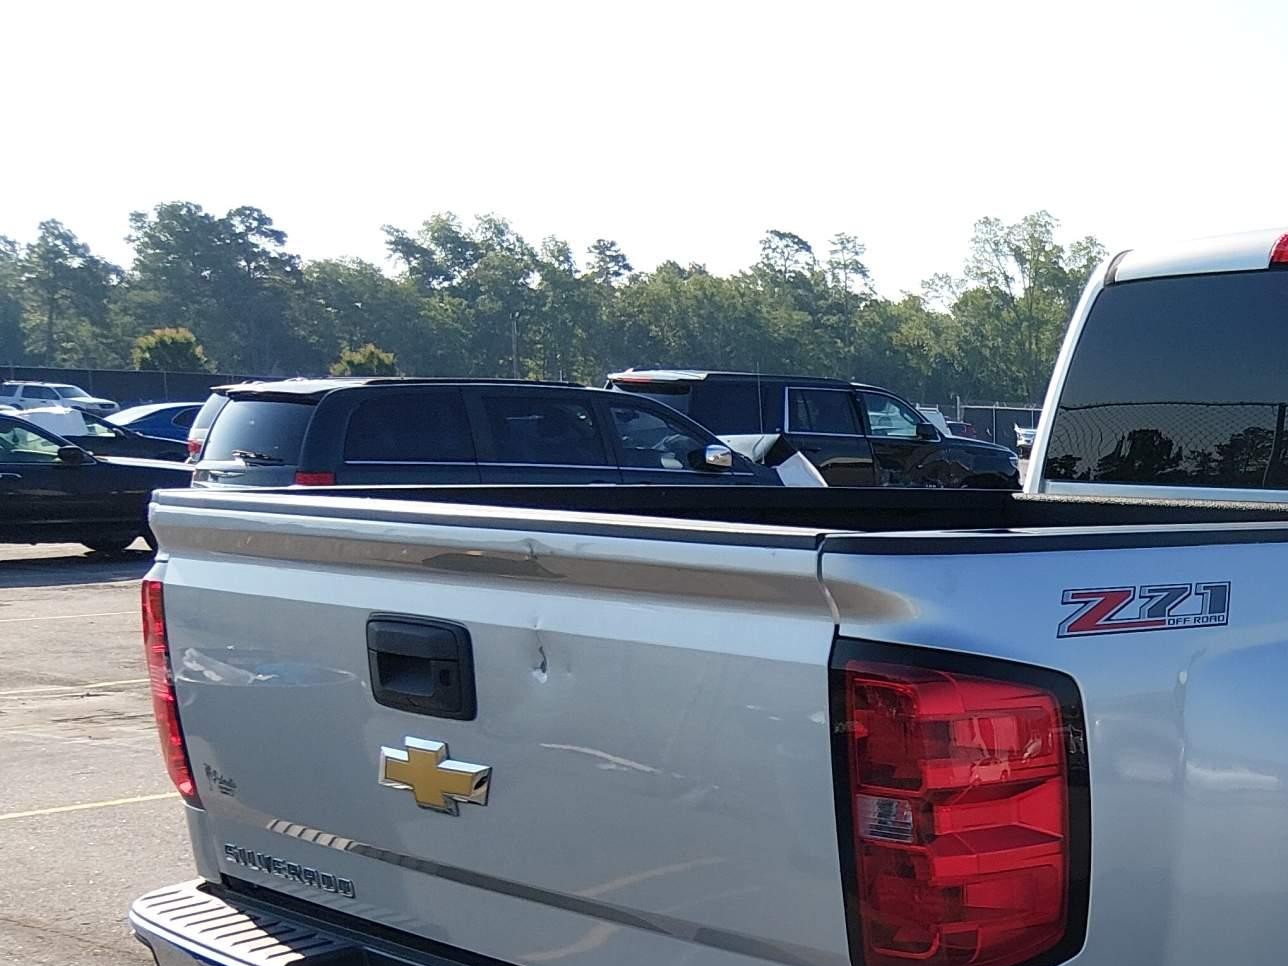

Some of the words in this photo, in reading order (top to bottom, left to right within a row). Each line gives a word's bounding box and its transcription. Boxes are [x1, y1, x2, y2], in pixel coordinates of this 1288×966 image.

[1056, 580, 1231, 639] Z71
[1167, 616, 1193, 626] OFF
[1194, 613, 1226, 624] ROAD
[224, 843, 357, 899] SILVERADO
